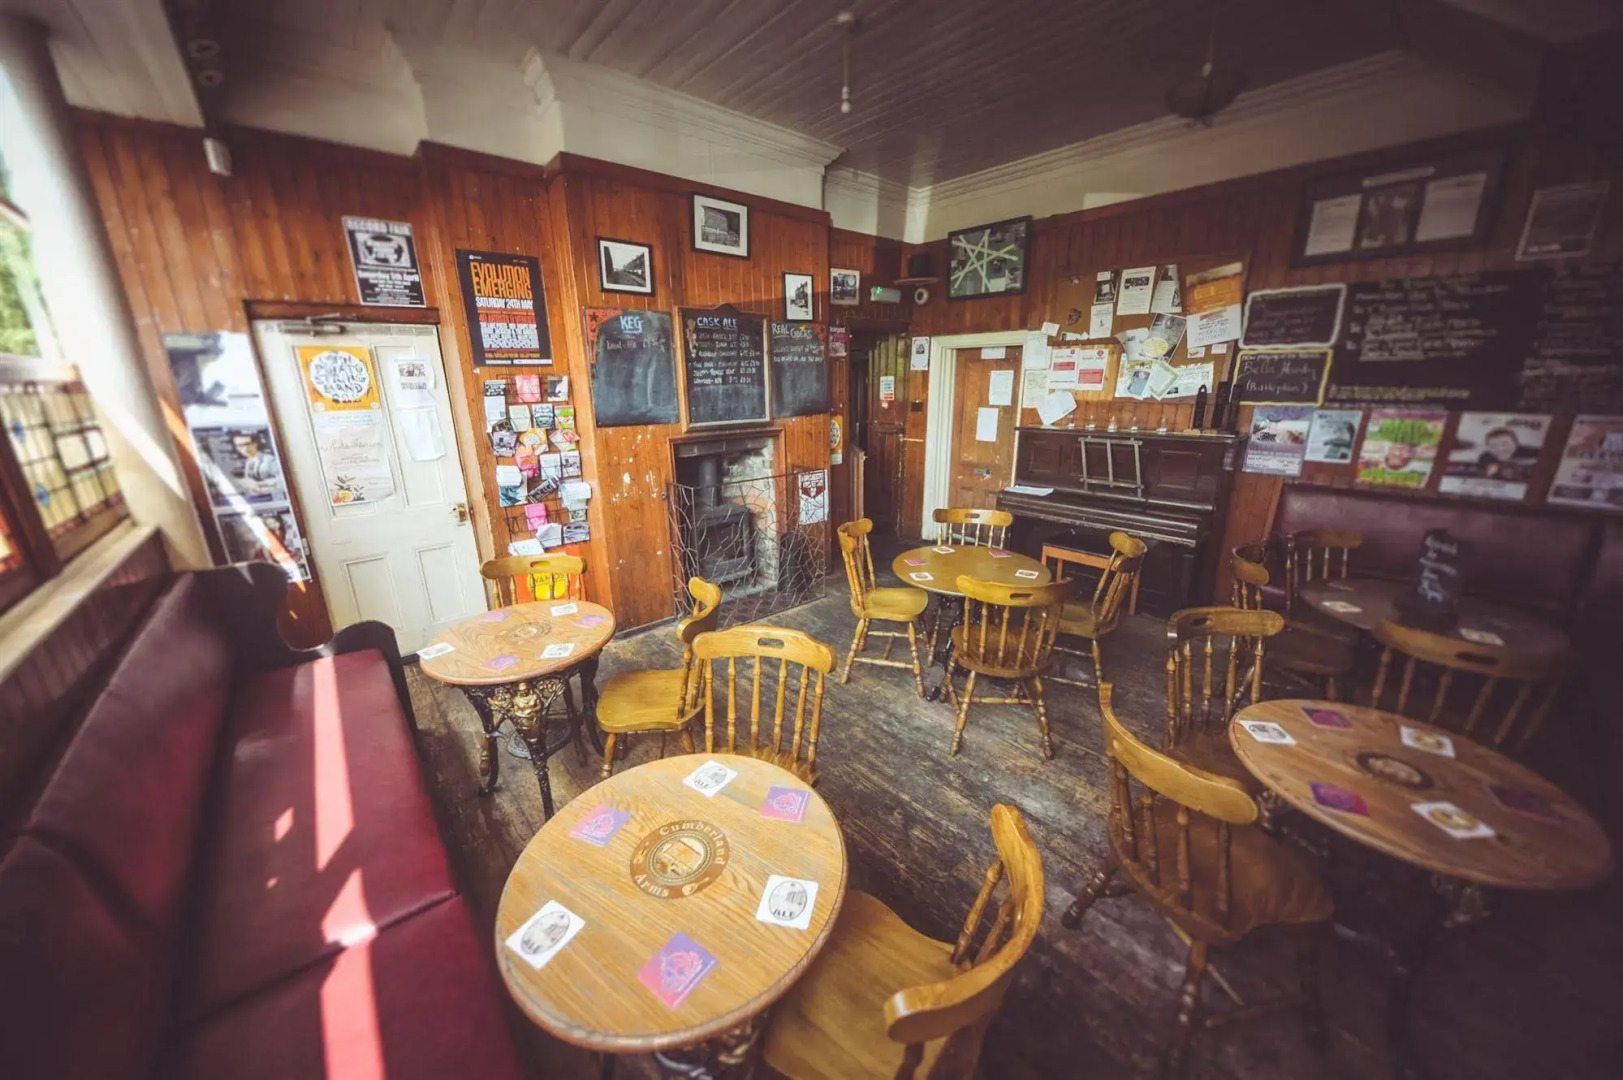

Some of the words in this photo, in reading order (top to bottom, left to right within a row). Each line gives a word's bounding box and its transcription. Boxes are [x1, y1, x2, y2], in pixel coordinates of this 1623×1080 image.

[470, 261, 531, 286] EVOLUTION
[473, 277, 533, 300] EMERGING
[620, 315, 643, 331] KEG
[697, 317, 720, 328] CASK
[723, 317, 737, 328] ALE
[772, 323, 790, 335] REAL
[659, 821, 726, 865] Cumberland
[634, 873, 670, 897] Arms
[772, 908, 796, 918] ALE
